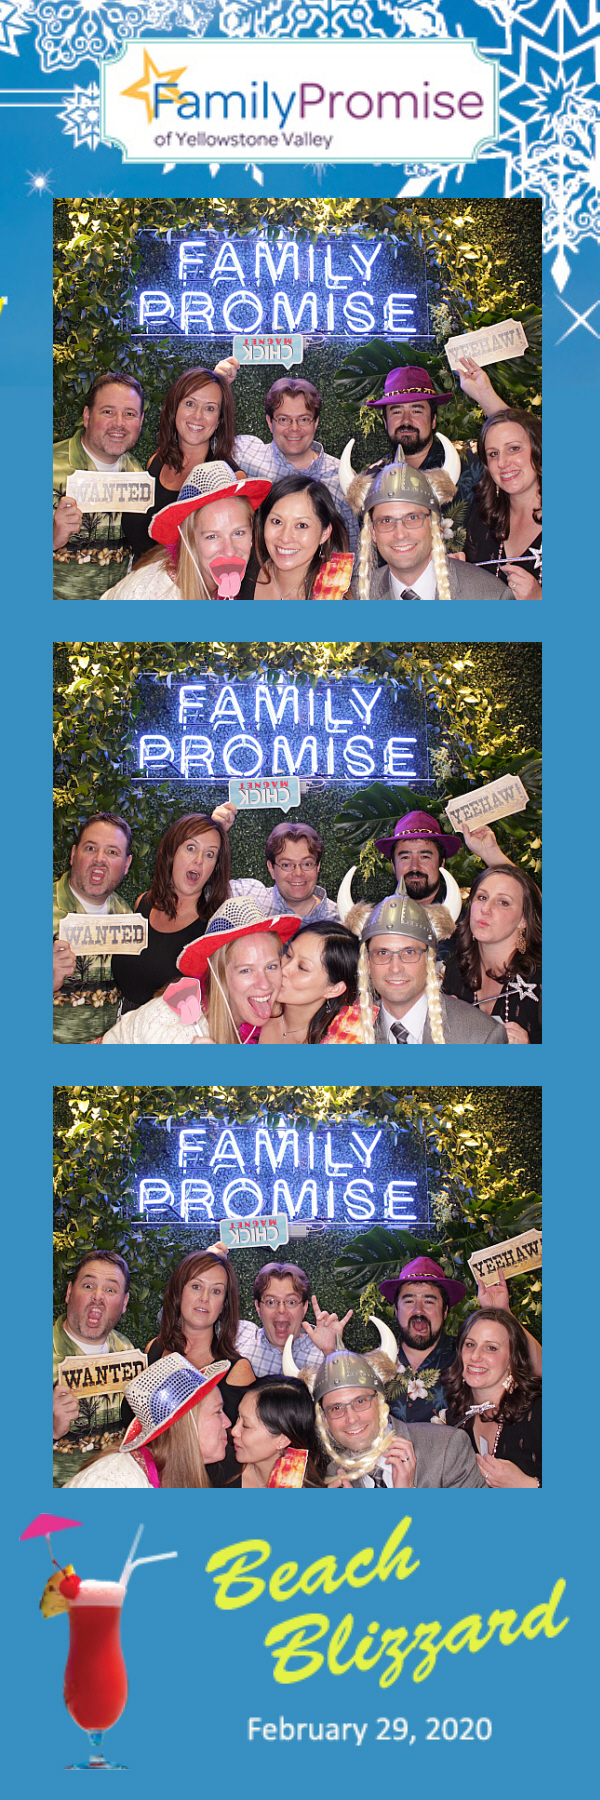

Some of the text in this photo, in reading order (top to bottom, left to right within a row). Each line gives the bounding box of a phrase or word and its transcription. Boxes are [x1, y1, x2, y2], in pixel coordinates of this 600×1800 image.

[178, 241, 383, 287] FAMILY
[138, 290, 418, 335] PROMISE
[242, 344, 293, 360] CHICK
[243, 337, 292, 345] MAGNET
[448, 328, 526, 363] YEEHAW!
[69, 482, 151, 502] WANTED
[178, 685, 383, 731] FAMILY
[138, 734, 418, 779] PROMISE
[238, 787, 290, 805] CHICK
[239, 780, 289, 790] MAGNET
[449, 783, 524, 825] YEEHAW!
[63, 924, 145, 945] WANTED
[178, 1129, 383, 1175] FAMILY
[138, 1178, 418, 1222] PROMISE
[229, 1218, 277, 1229] MAGNET
[229, 1226, 279, 1244] CHICK
[472, 1238, 542, 1277] YEEHAW
